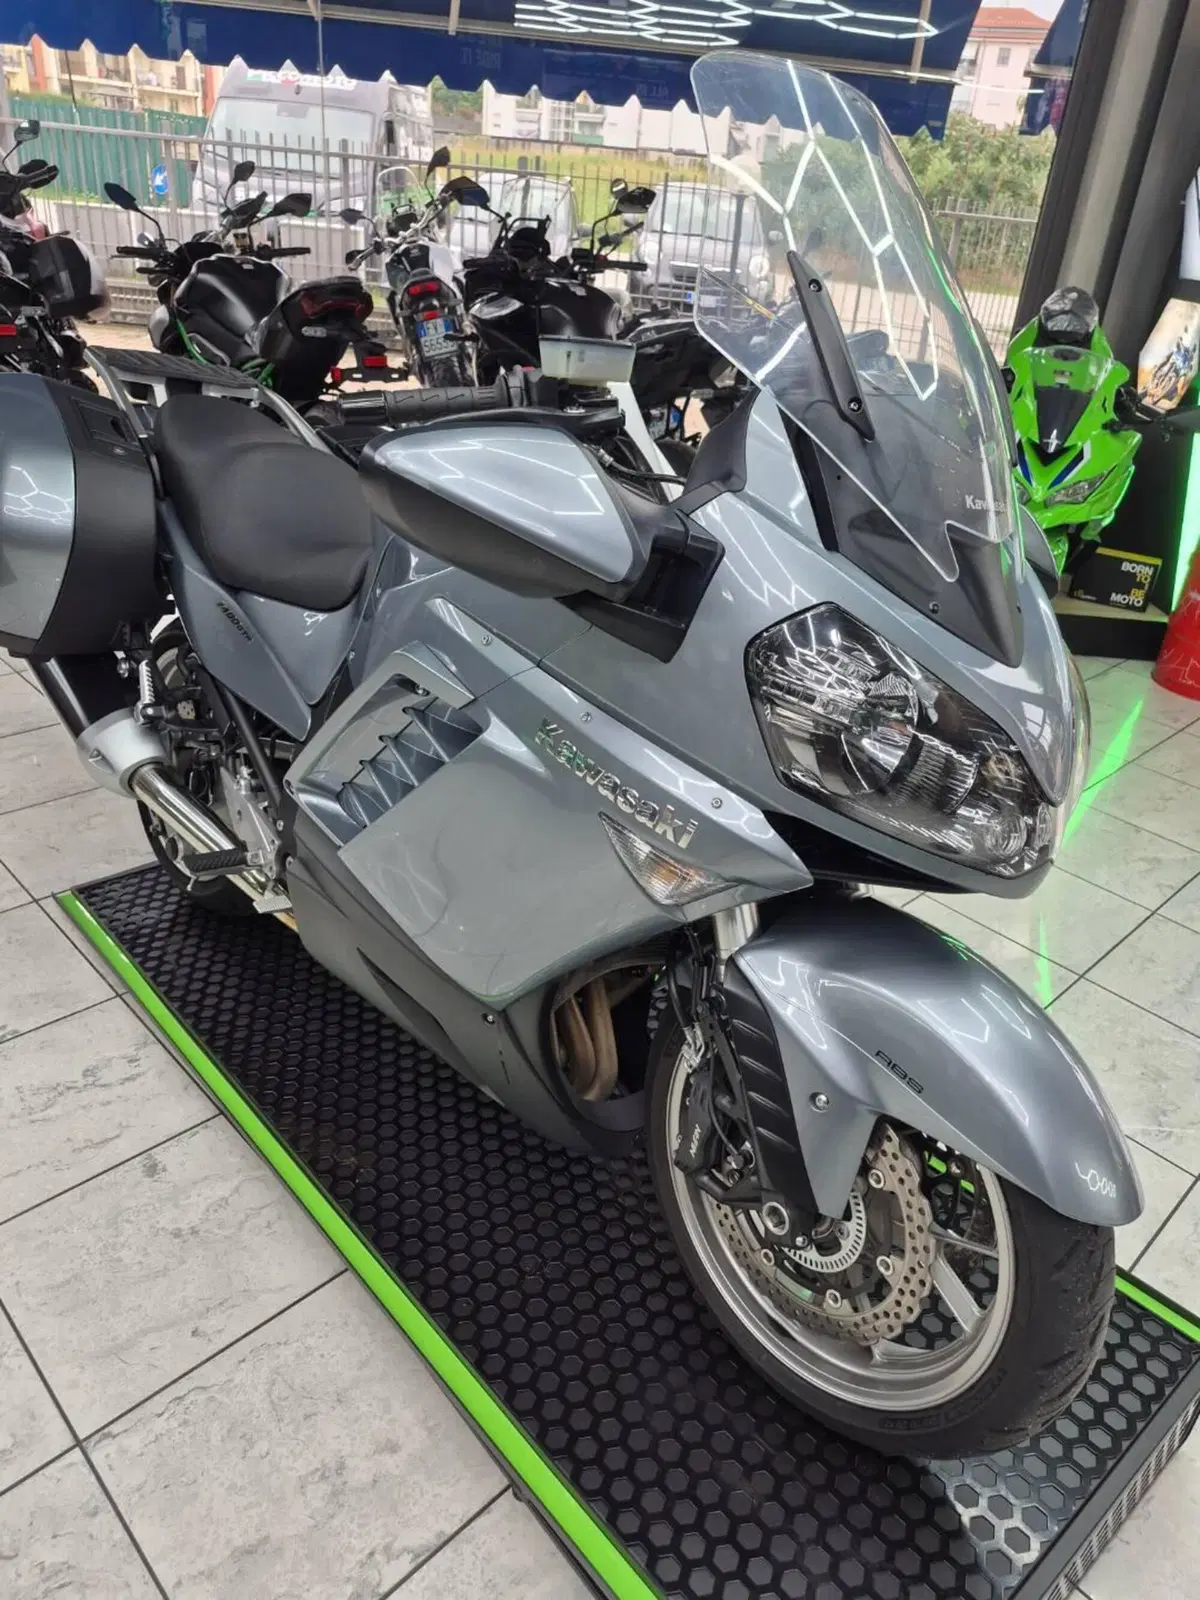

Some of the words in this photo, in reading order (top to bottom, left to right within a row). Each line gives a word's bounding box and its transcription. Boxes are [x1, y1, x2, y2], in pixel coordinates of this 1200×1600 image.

[1121, 561, 1155, 576] BORN
[1136, 573, 1151, 584] TO
[1110, 592, 1144, 607] MOTO
[1130, 588, 1145, 599] BE
[534, 714, 699, 849] Kawasaki
[875, 1050, 924, 1094] ABS
